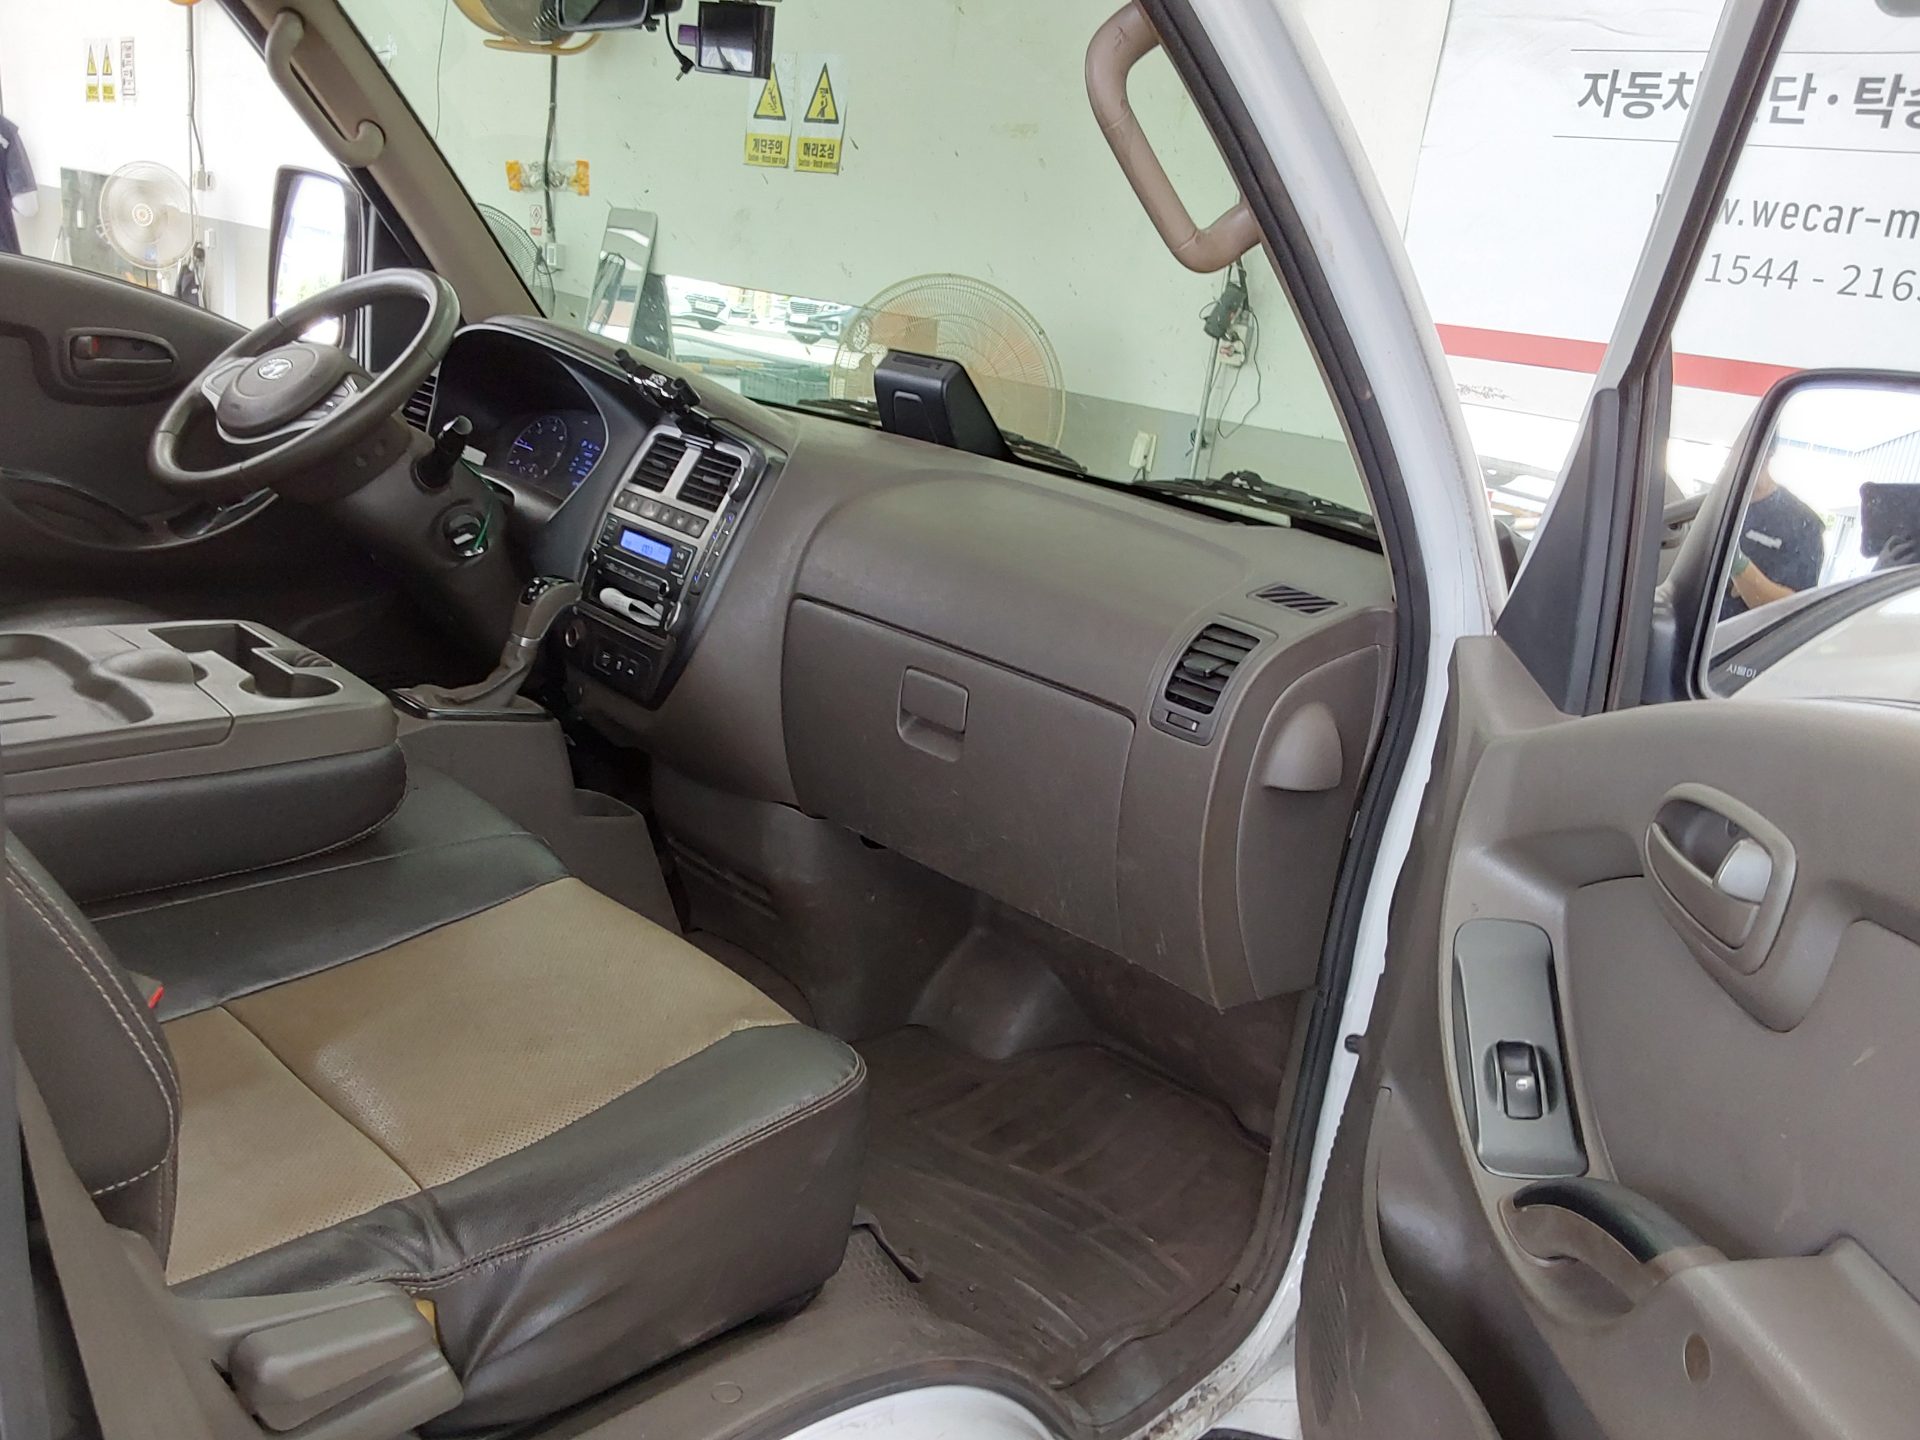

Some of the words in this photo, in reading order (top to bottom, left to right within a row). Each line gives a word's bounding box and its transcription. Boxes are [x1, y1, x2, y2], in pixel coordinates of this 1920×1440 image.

[803, 142, 835, 160] 머리조심
[1704, 253, 1799, 290] 1544
[1836, 264, 1920, 303] 216
